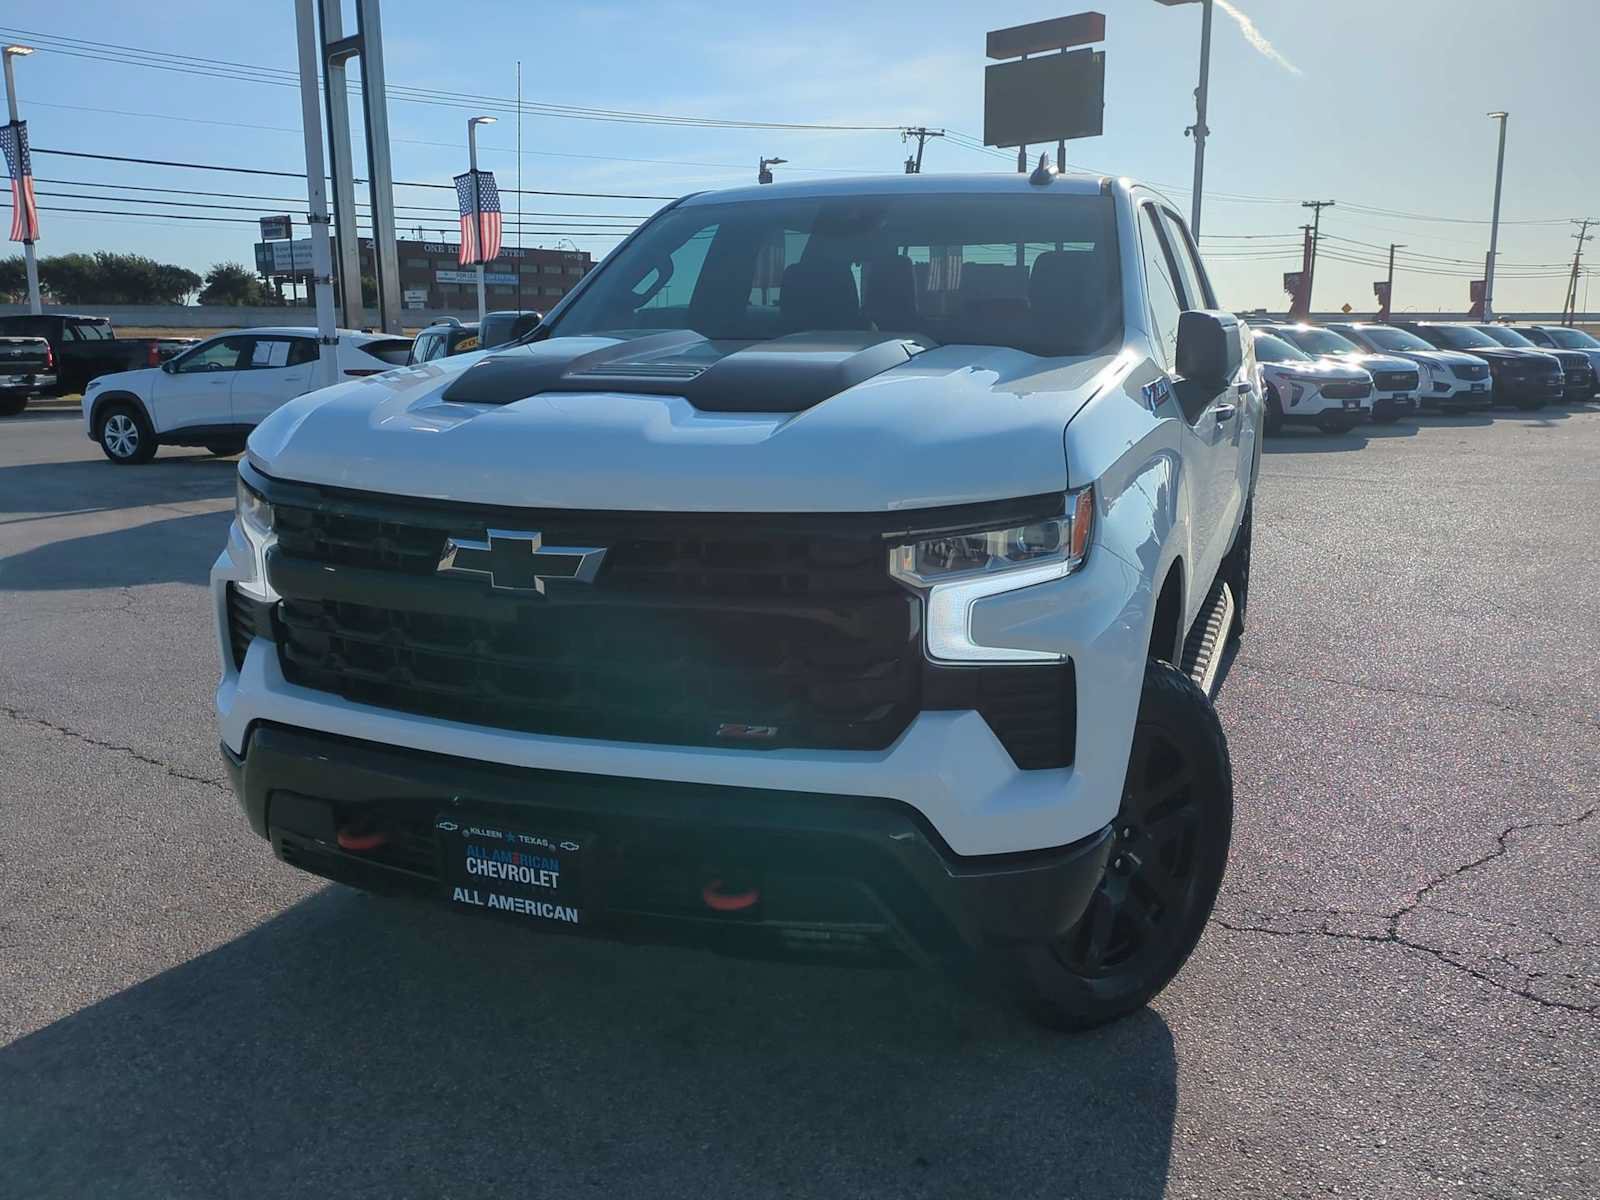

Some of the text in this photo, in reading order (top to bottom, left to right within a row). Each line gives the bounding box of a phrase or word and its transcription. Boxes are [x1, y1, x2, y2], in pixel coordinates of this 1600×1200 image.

[424, 242, 445, 253] ONE
[470, 827, 549, 847] KILLEEN TEXAS
[467, 845, 560, 871] ALL AMERICAN
[466, 857, 559, 888] CHEVROLET
[453, 887, 578, 923] ALL AMERICAN
